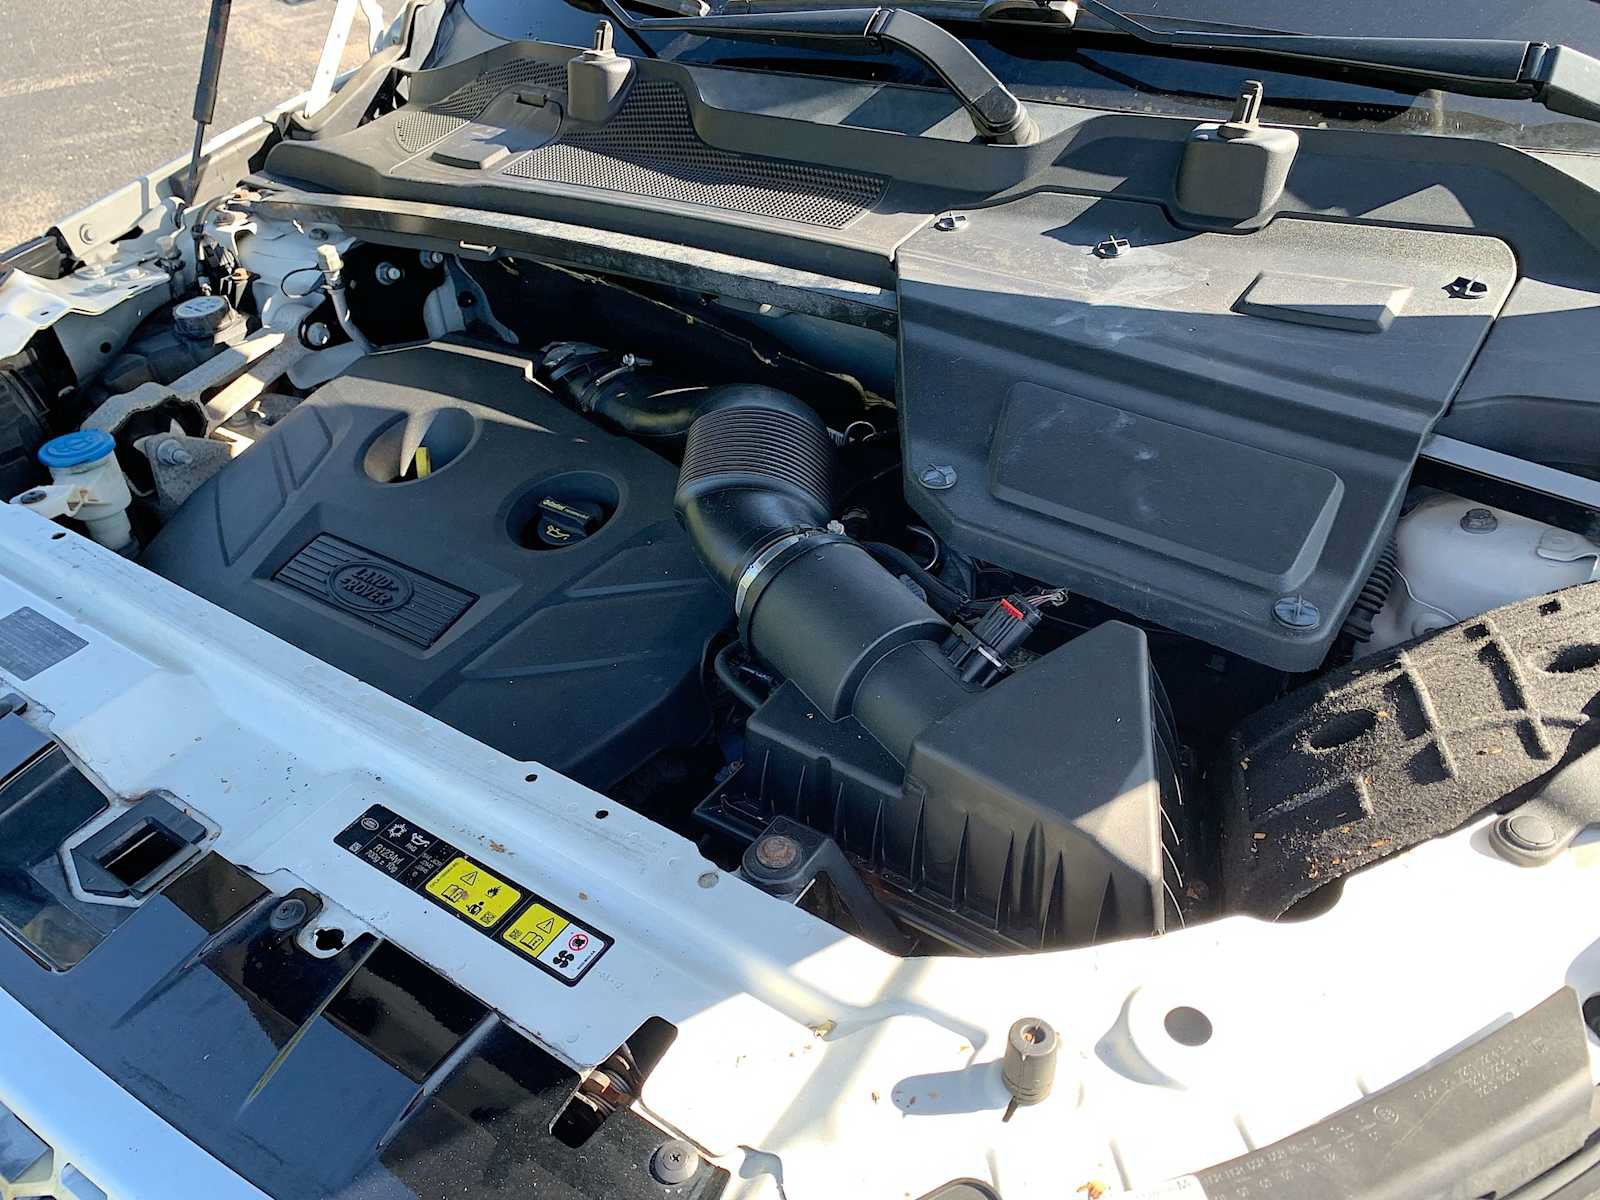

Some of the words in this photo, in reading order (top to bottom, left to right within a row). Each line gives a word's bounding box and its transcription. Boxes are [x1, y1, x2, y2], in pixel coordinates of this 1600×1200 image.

[352, 568, 393, 589] LAND
[343, 578, 393, 605] ROVER
[373, 843, 405, 864] R1234yf
